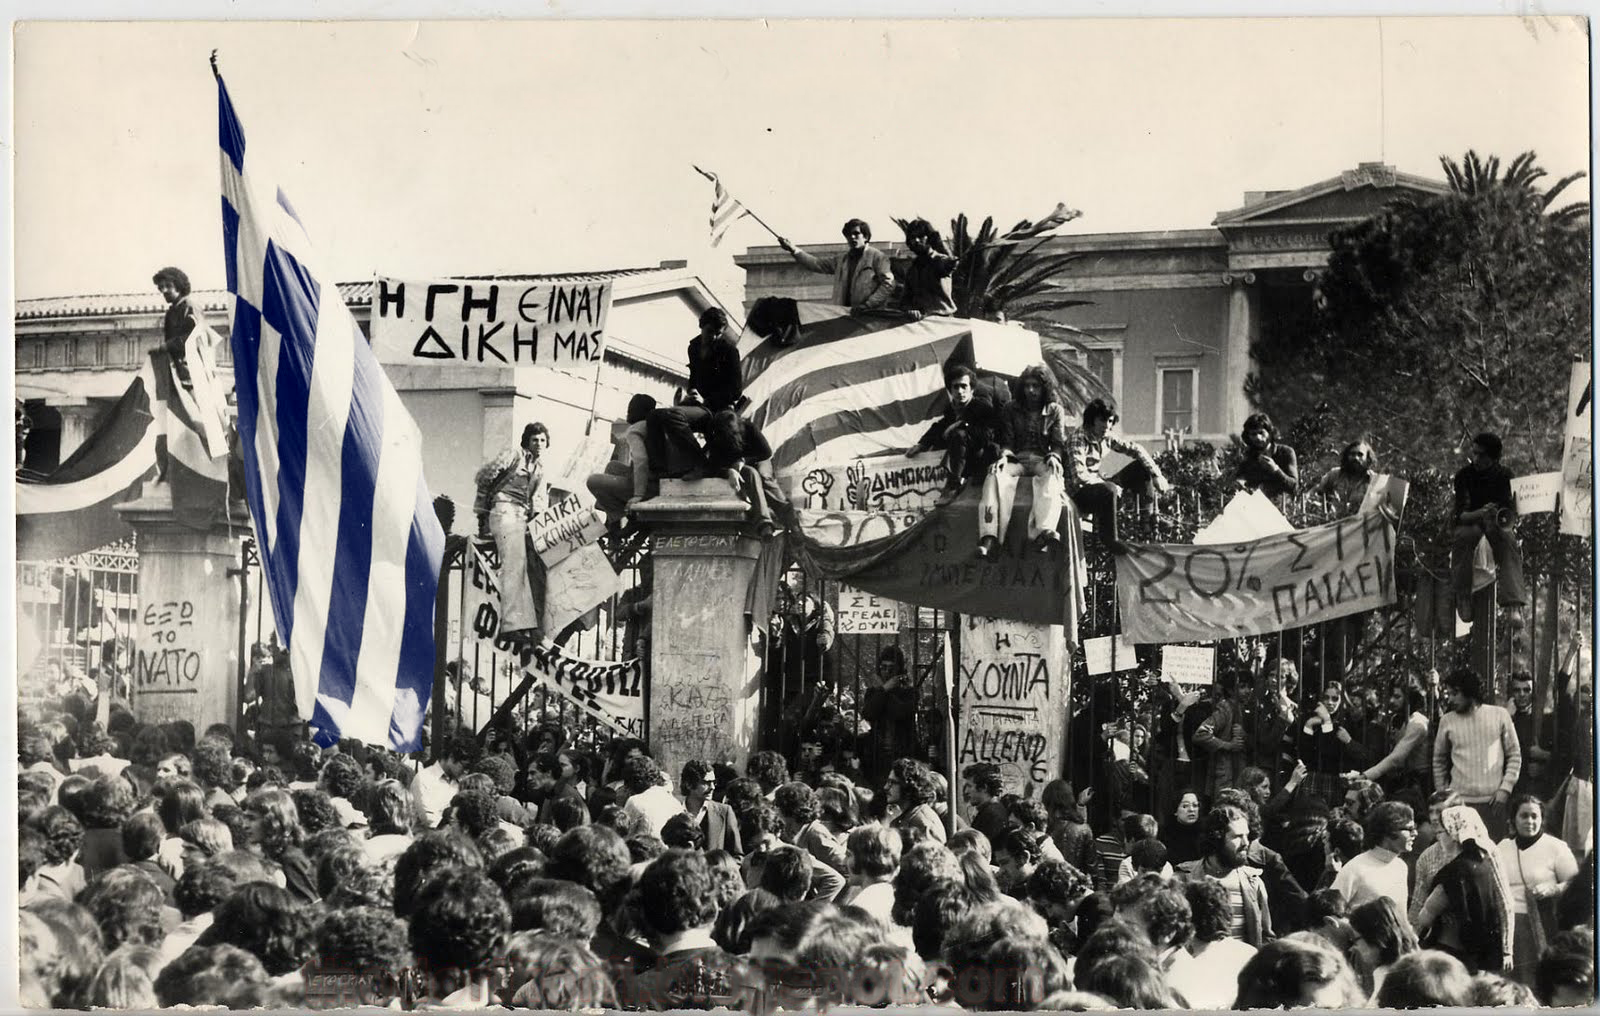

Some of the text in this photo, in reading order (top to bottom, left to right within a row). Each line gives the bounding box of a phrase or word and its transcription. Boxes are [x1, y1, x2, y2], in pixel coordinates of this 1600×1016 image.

[379, 281, 605, 325] Η ΓΗ ΕΙΝΑΙ
[413, 321, 603, 365] ΔΙΚΗ ΜΑΣ
[535, 493, 582, 535] ΛΑΙΚΗ
[1130, 539, 1263, 606] 20%
[837, 609, 897, 620] ΤΡΕΜΕΙ
[849, 596, 881, 608] ΣΕ
[152, 630, 177, 644] ΤΟ
[995, 632, 1011, 650] Η
[138, 648, 200, 686] ΝΑΤΟ
[960, 653, 1050, 701] ΧΟΥΝΤΑ
